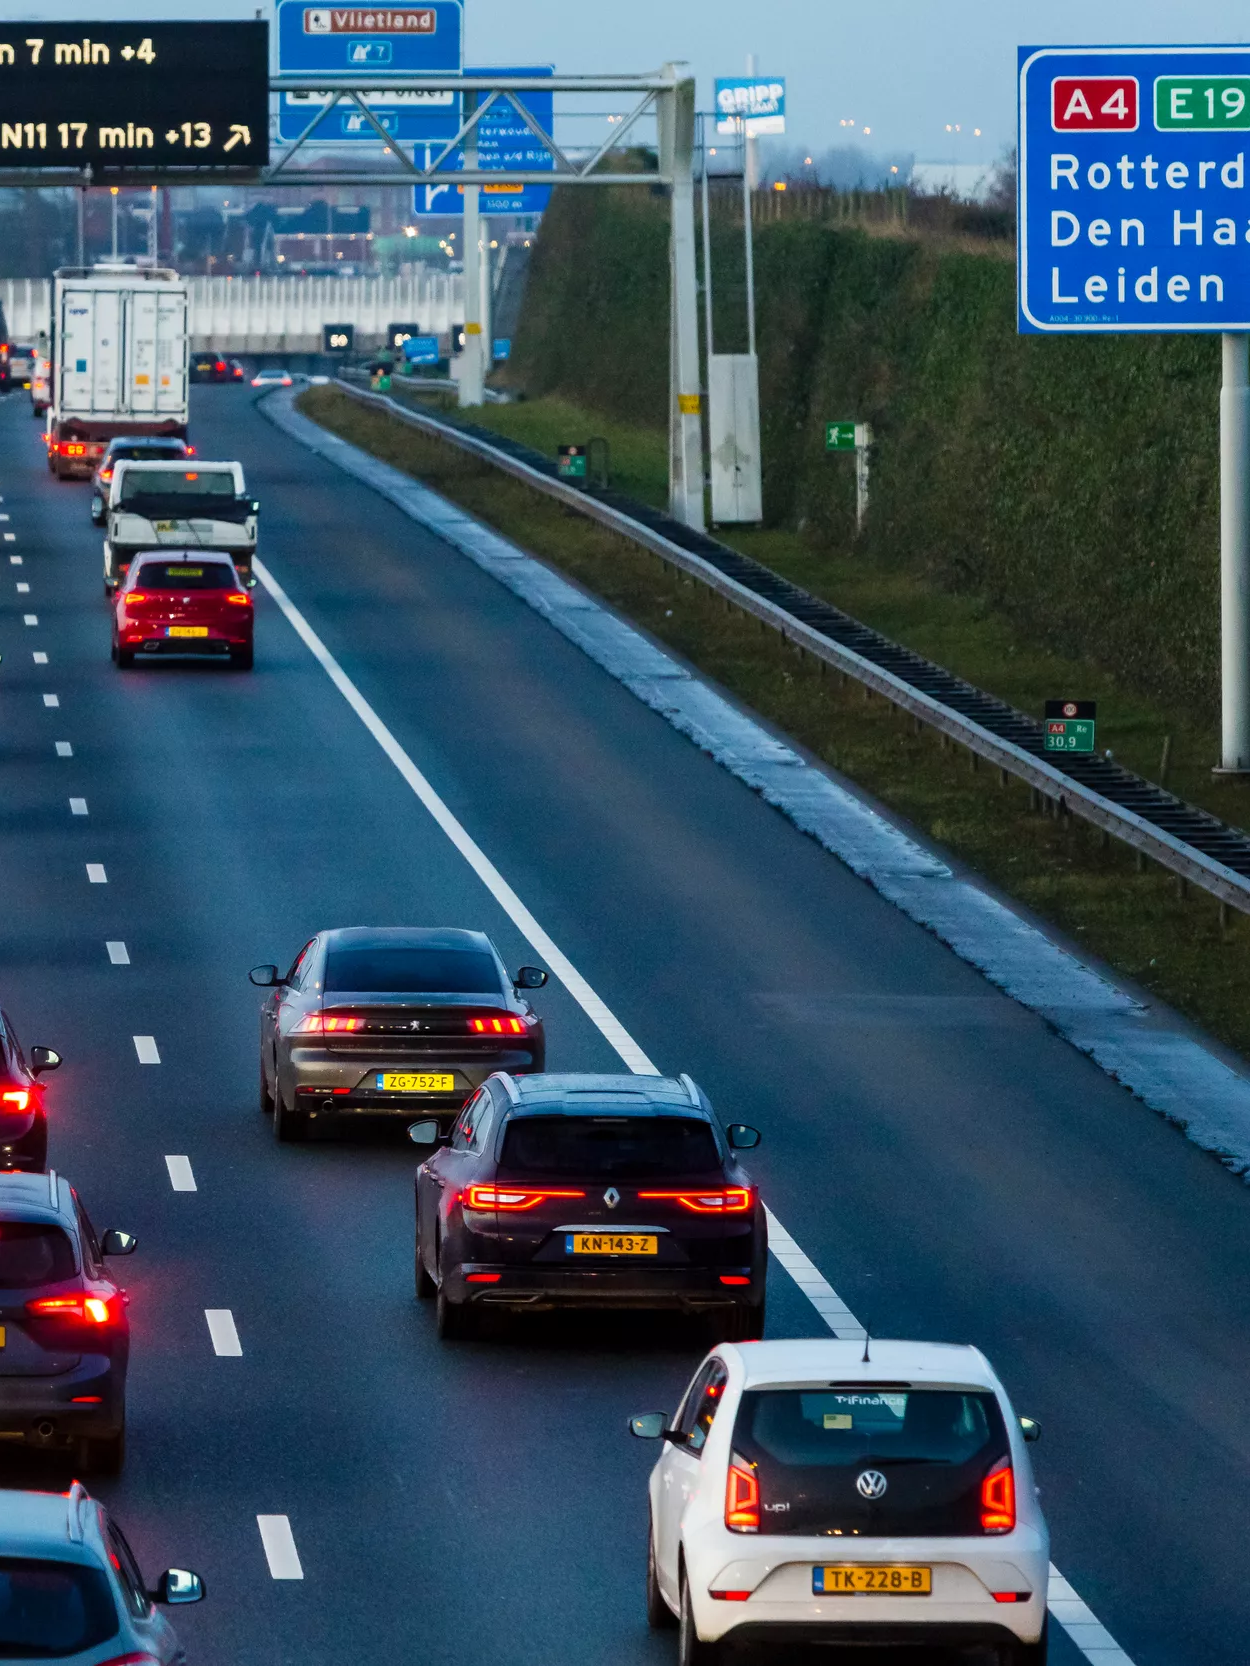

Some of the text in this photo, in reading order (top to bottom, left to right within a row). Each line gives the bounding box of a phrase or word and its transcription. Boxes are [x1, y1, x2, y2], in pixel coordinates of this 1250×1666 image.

[335, 11, 431, 28] Vlietland
[26, 40, 44, 65] 7
[56, 40, 110, 65] min
[121, 40, 156, 65] +4
[377, 47, 385, 57] 7
[1063, 88, 1246, 121] A4 E19
[1, 124, 48, 149] N11
[58, 124, 87, 149] 17
[99, 124, 154, 149] min
[165, 124, 211, 148] +13
[1051, 152, 1245, 190] Rotterd
[1051, 209, 1250, 246] Den Ha
[1052, 266, 1224, 303] Leiden
[1052, 724, 1064, 732] A4
[389, 1076, 448, 1088] ZG-752-F
[581, 1237, 649, 1252] KN-143-Z
[764, 1502, 791, 1513] up!
[831, 1570, 923, 1589] TK-228-B
